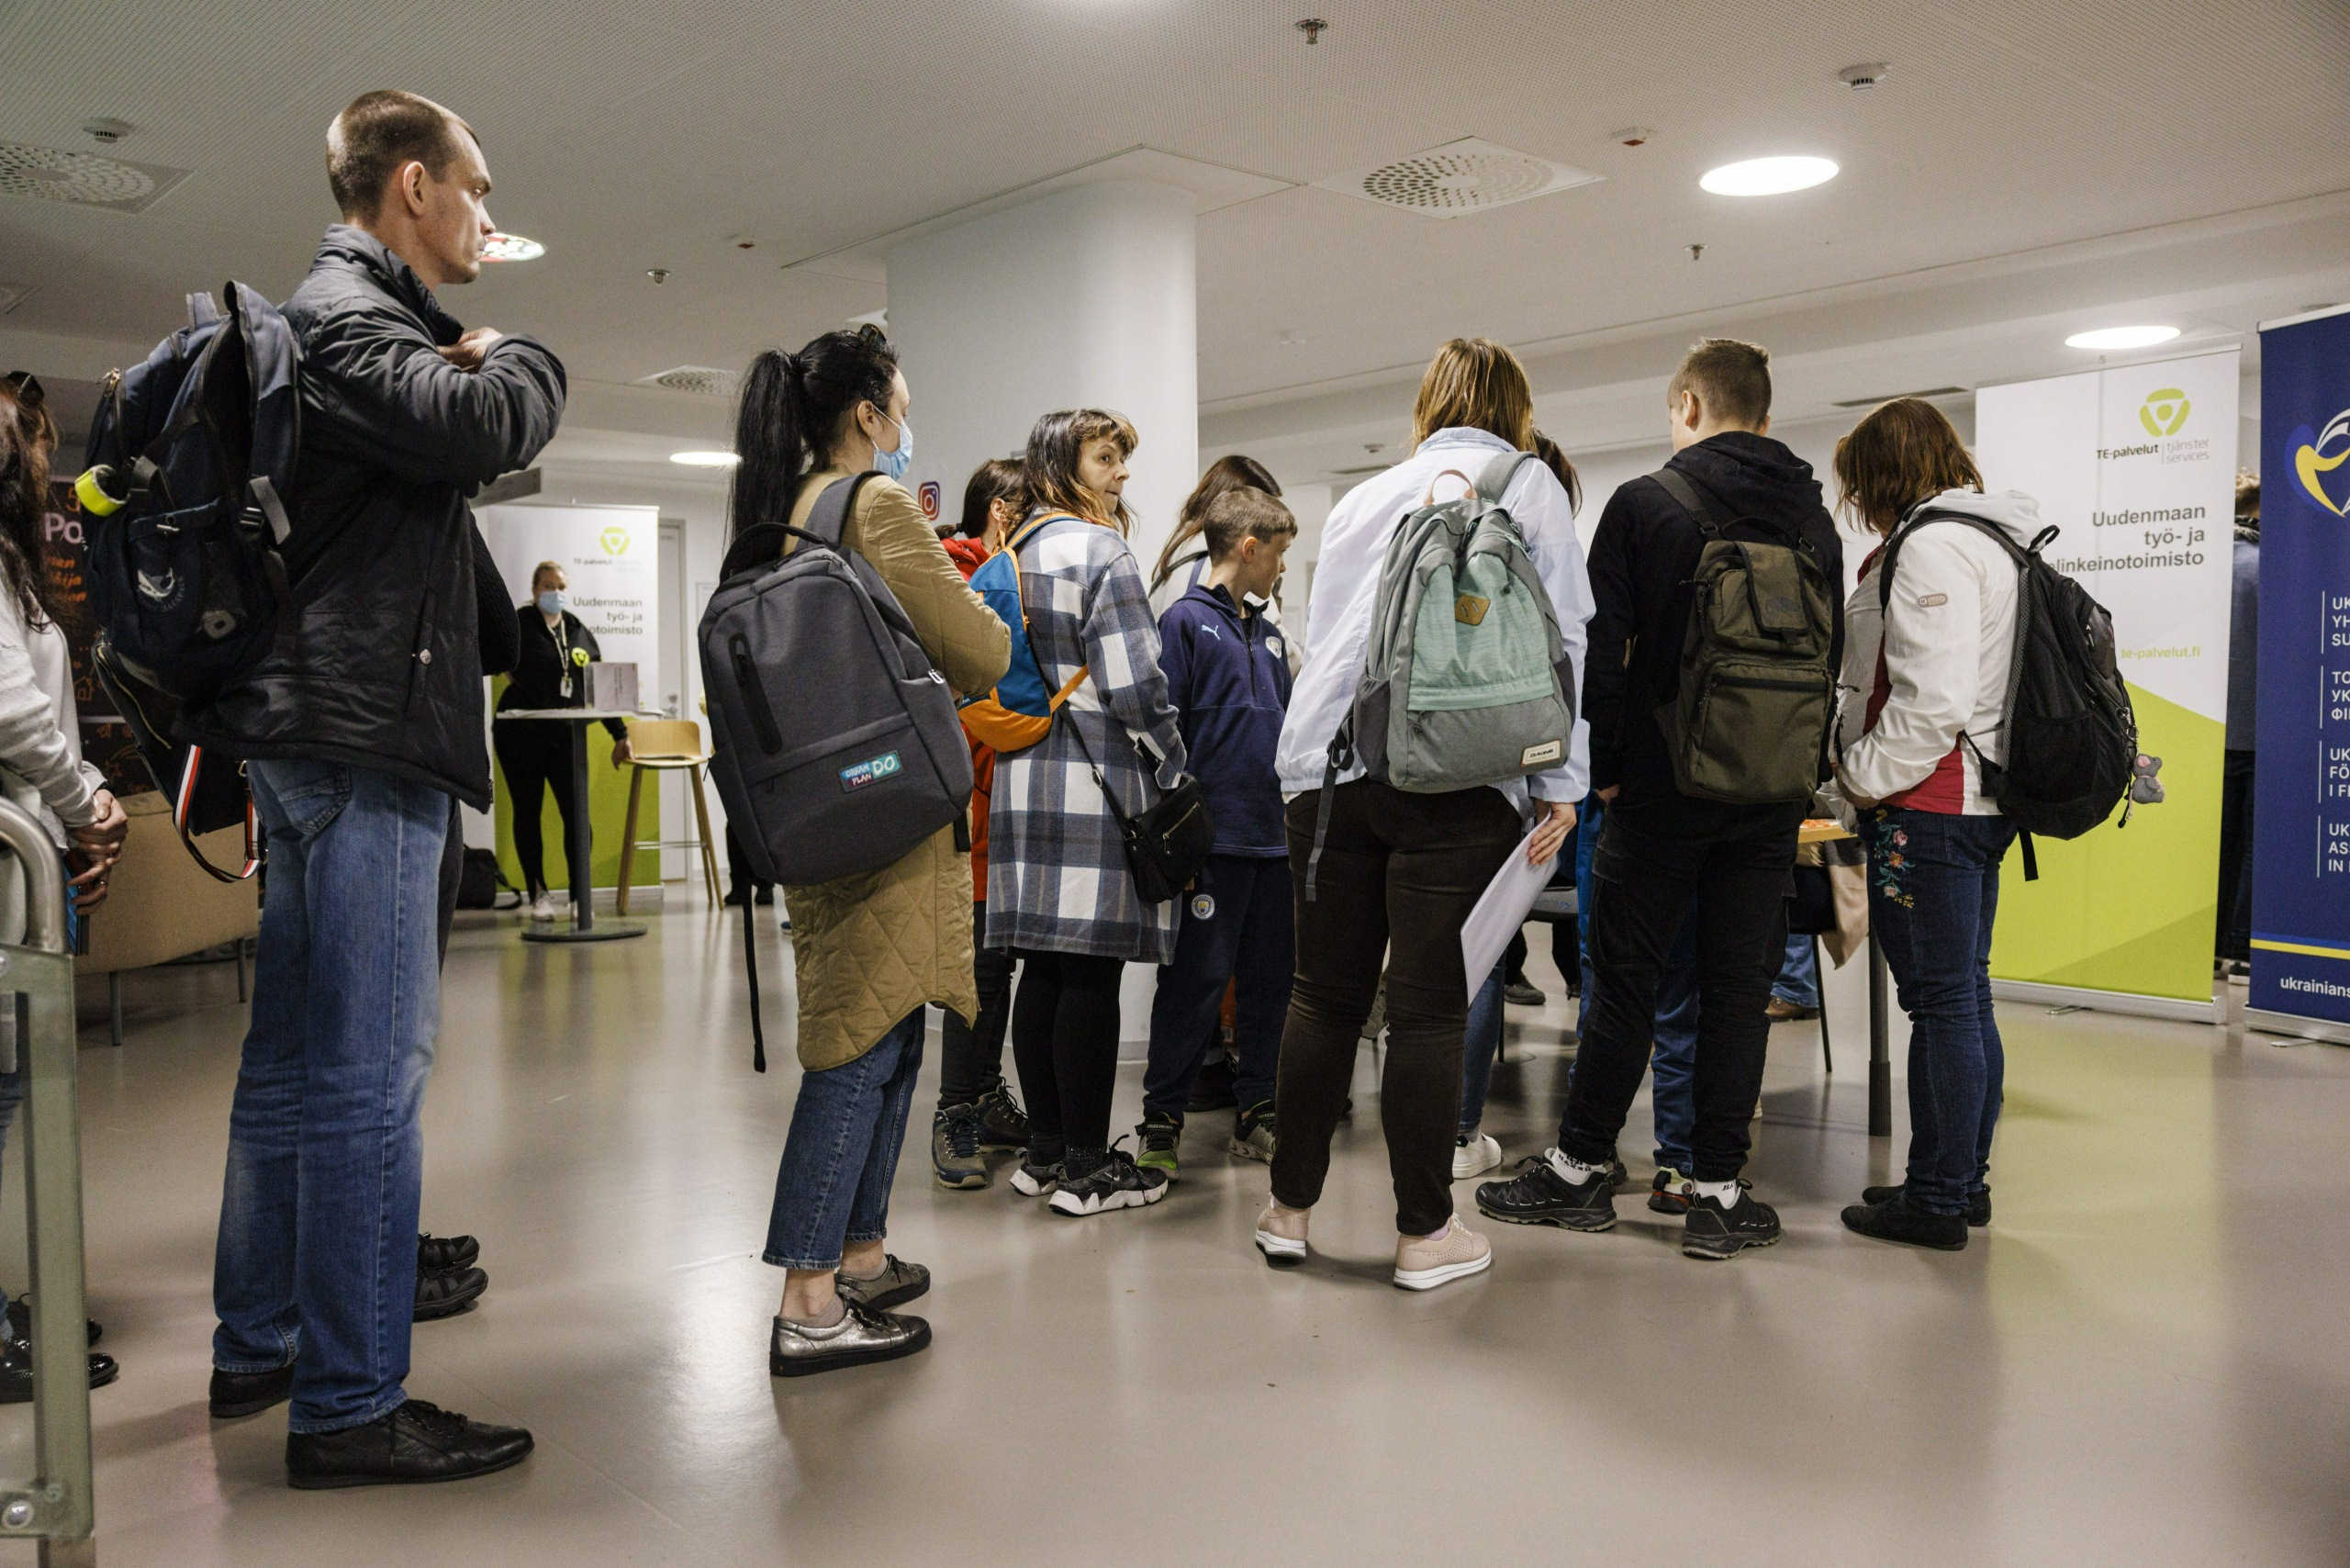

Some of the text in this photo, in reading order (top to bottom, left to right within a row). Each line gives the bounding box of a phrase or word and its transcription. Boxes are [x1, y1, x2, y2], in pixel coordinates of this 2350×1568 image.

[2096, 439, 2210, 460] TE-palvelut tjänster
[2166, 451, 2210, 465] services
[2092, 506, 2206, 527] Uudenmaan
[2144, 526, 2205, 549] työ- ja
[573, 597, 643, 607] Uudenmaan
[607, 611, 643, 623] työ- ja
[2332, 633, 2350, 646] SU
[2121, 645, 2201, 660] te-palvelut.fi
[2330, 747, 2350, 761] UK
[845, 764, 869, 777] DREAM
[872, 756, 895, 775] DO
[2330, 763, 2350, 779] FÖ
[852, 773, 872, 785] PLAN
[2329, 823, 2349, 836] UK
[2328, 841, 2350, 855] AS
[2328, 858, 2344, 872] IN
